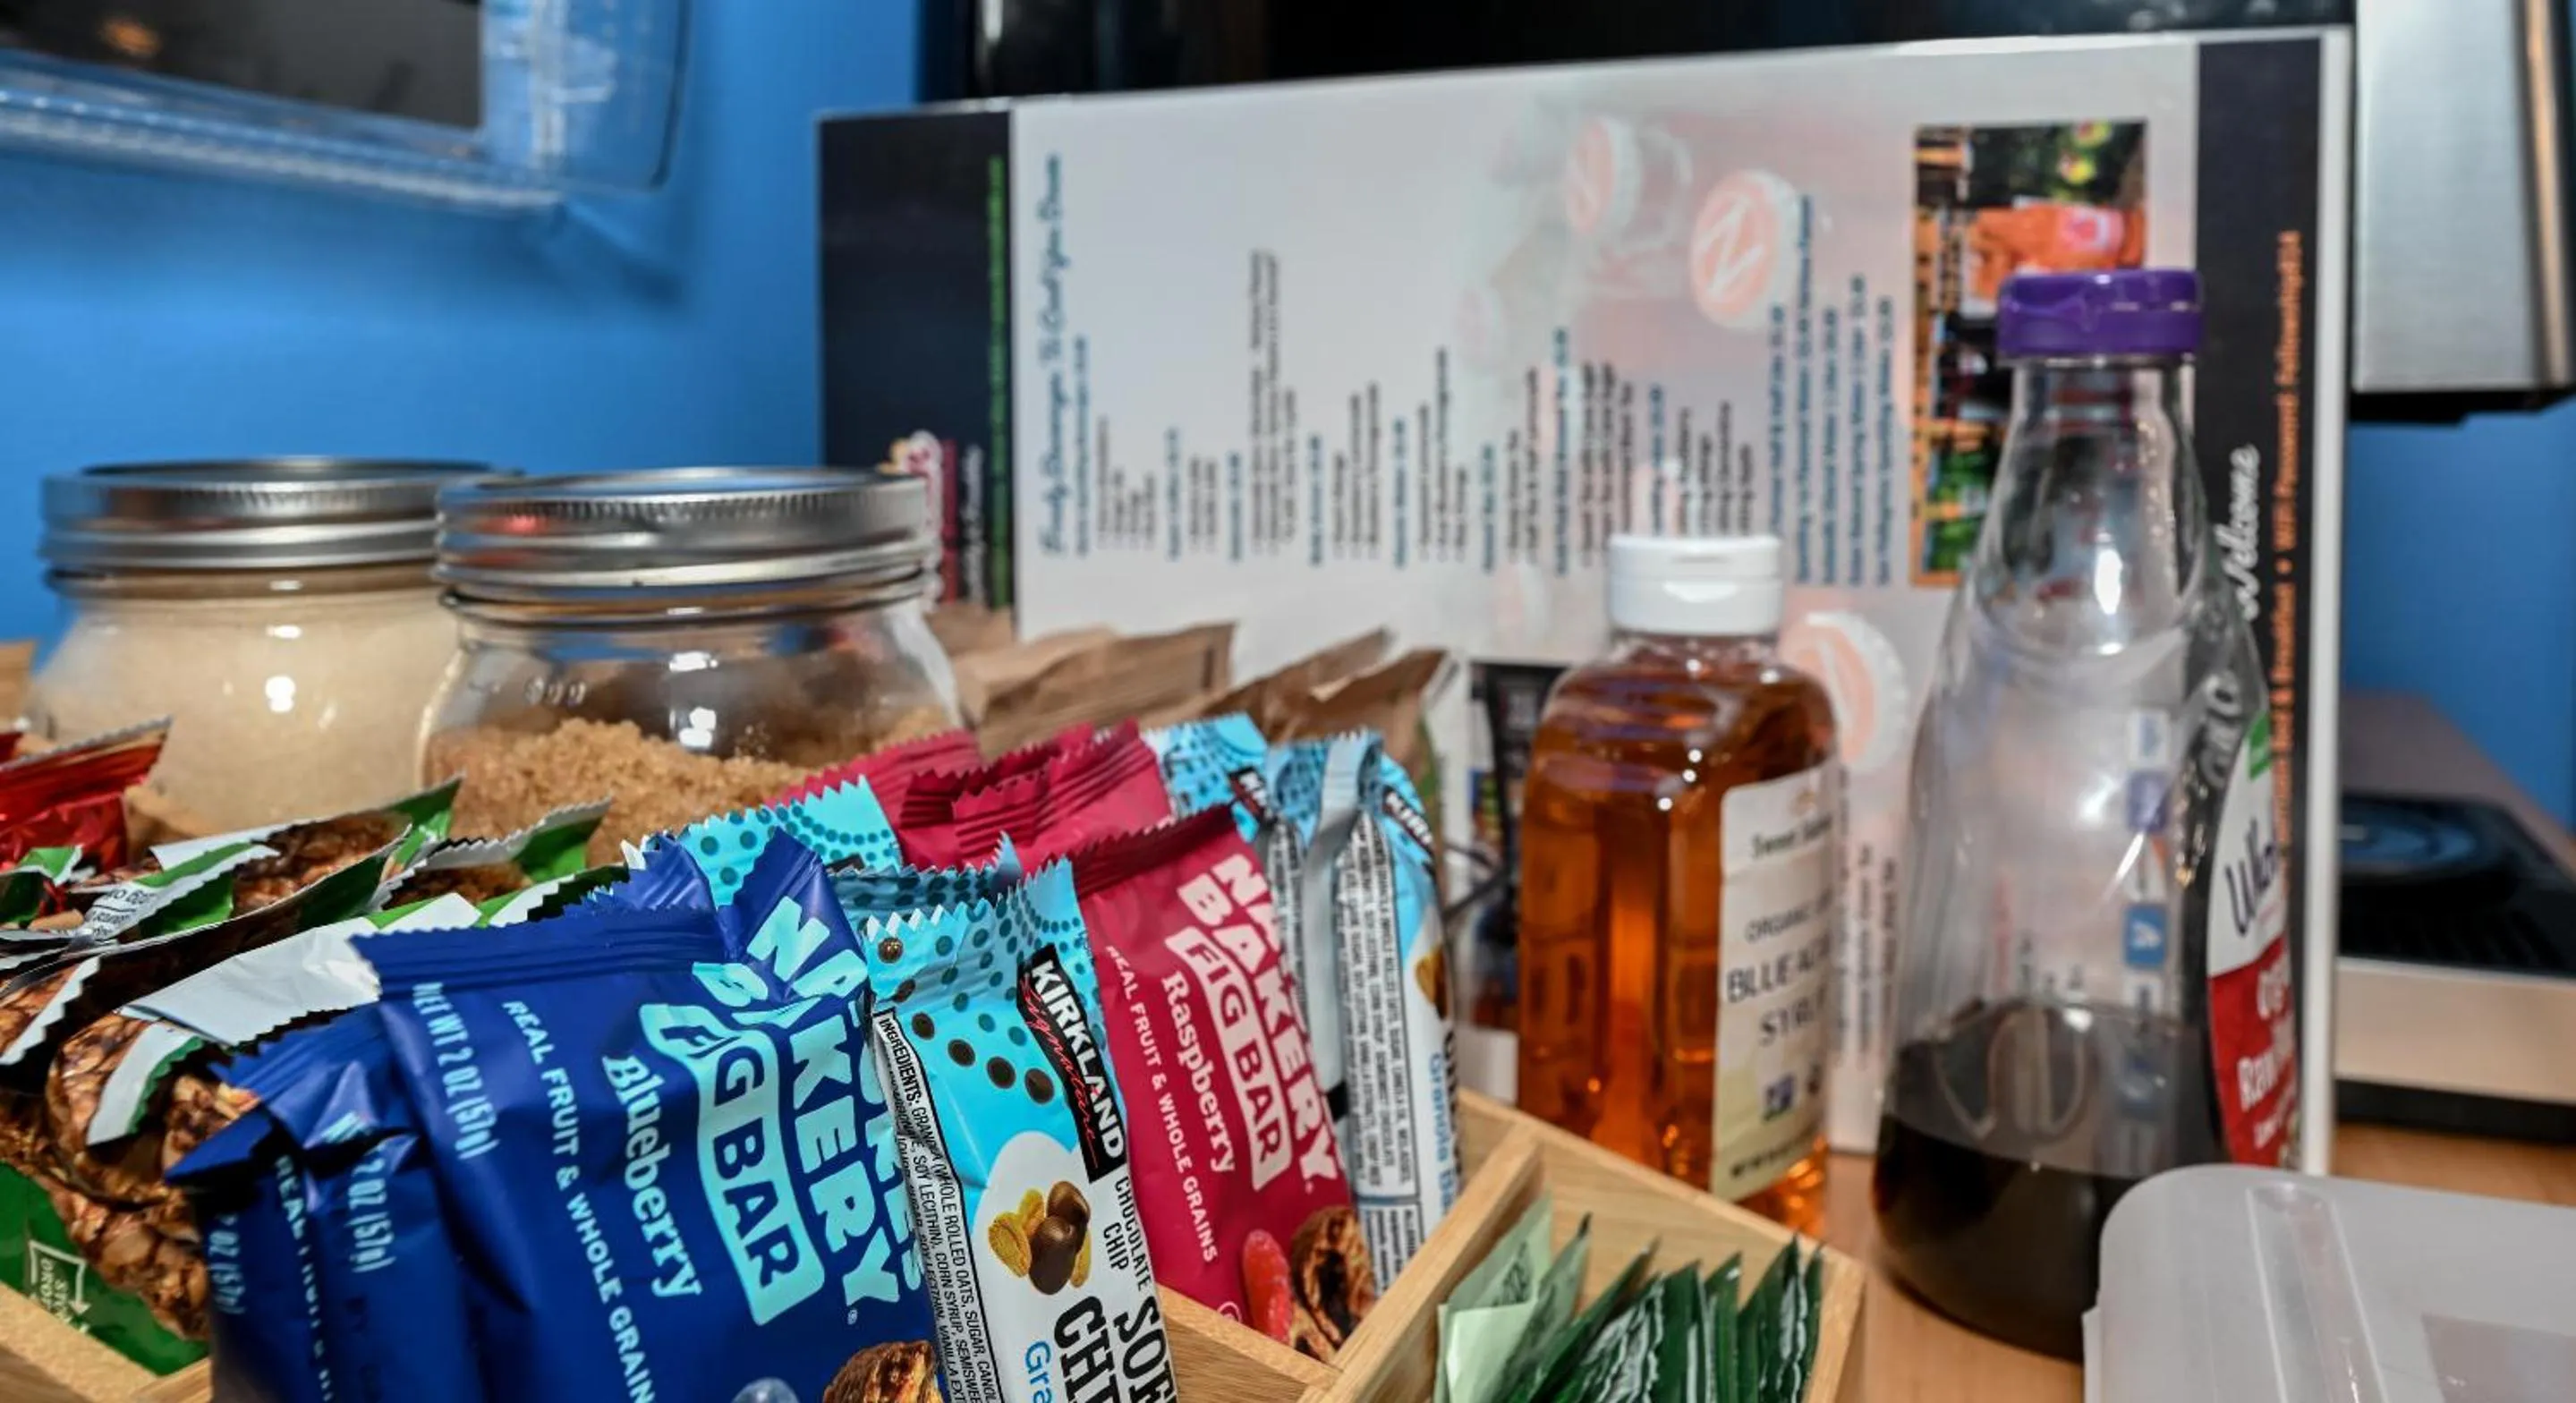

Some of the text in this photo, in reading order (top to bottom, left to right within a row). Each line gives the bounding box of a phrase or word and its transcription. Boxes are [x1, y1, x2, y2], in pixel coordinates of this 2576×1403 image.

[427, 1013, 474, 1047] WT
[438, 1046, 473, 1067] 2
[502, 1000, 556, 1065] REAL
[1031, 960, 1125, 1160] KIRKLAND
[1129, 1003, 1162, 1068] FRUIT
[1177, 872, 1338, 1183] BAKERY
[1185, 941, 1248, 1029] FIG
[1234, 1048, 1280, 1162] BAR
[442, 1066, 483, 1098] OZ
[879, 1017, 922, 1107] INGREDIENTS:
[1152, 1072, 1167, 1093] &
[1160, 969, 1236, 1173] Raspberry
[540, 1067, 580, 1156] FRUIT
[1158, 1093, 1194, 1174] WHOLE
[556, 1166, 581, 1192] &
[601, 1055, 703, 1297] Blueberry
[914, 1155, 932, 1183] SOY
[712, 1117, 800, 1288] BAR
[1113, 1175, 1153, 1293] CHOCOLATE
[1182, 1176, 1218, 1263] GRAINS
[566, 1193, 623, 1305] WHOLE
[935, 1253, 955, 1288] CORN
[944, 1212, 966, 1267] ROLLED
[1102, 1221, 1130, 1272] CHIP
[943, 1290, 965, 1337] SYRUP,
[956, 1271, 975, 1308] OATS,
[965, 1310, 985, 1357] SUGAR,
